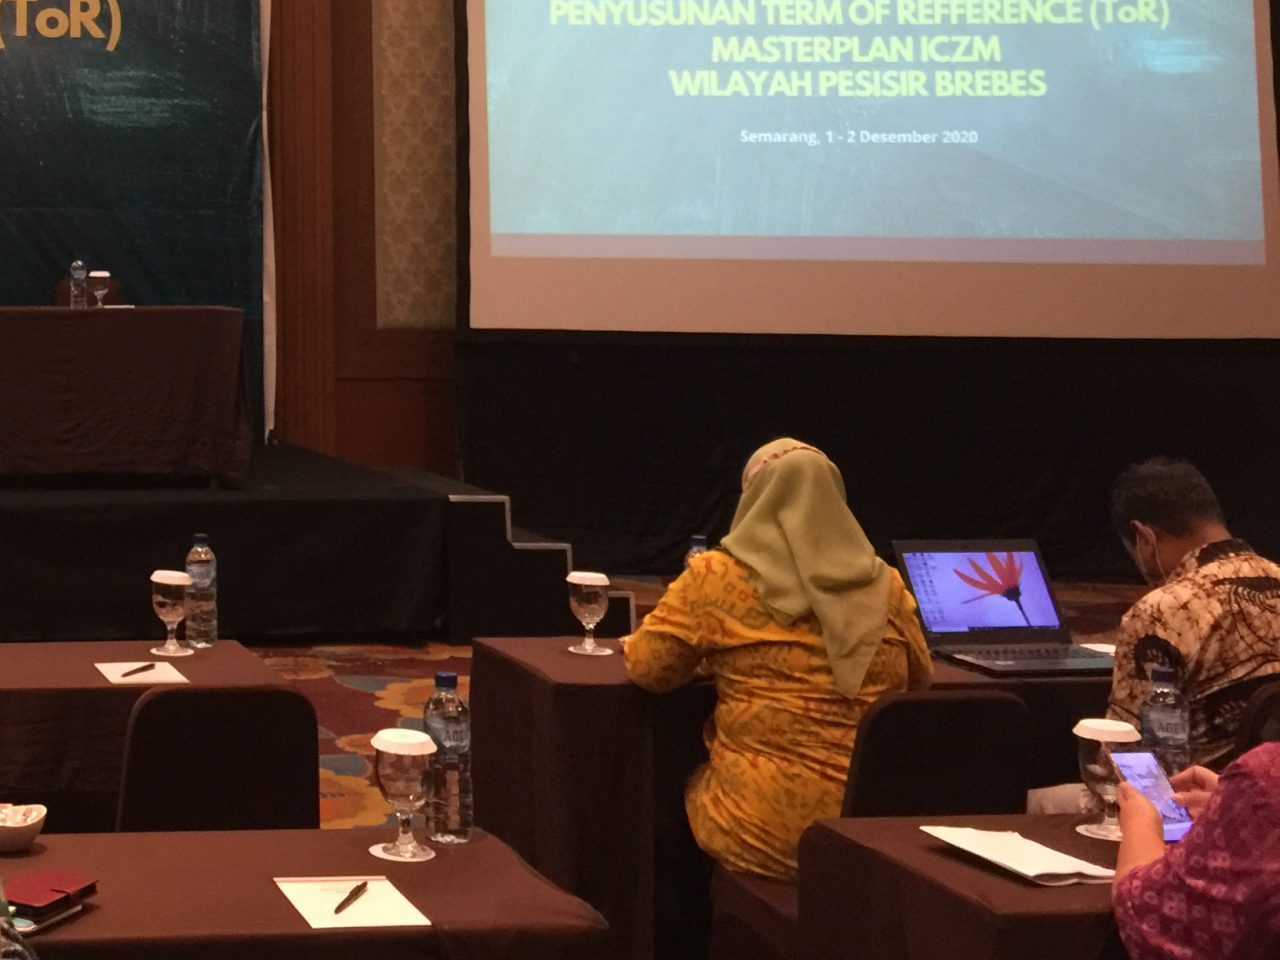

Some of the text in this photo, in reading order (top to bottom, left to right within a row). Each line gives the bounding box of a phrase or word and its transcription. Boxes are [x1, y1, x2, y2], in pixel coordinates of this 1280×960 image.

[549, 0, 756, 26] PENYUSUNAN
[711, 35, 1002, 63] MASTERPLAN ICZM
[668, 70, 1048, 97] WILAYAH PESISIR BREBES
[740, 130, 821, 146] Semarang,
[825, 131, 833, 143] 1
[847, 130, 856, 143] 2
[860, 130, 938, 144] Desember
[942, 130, 979, 143] 2020
